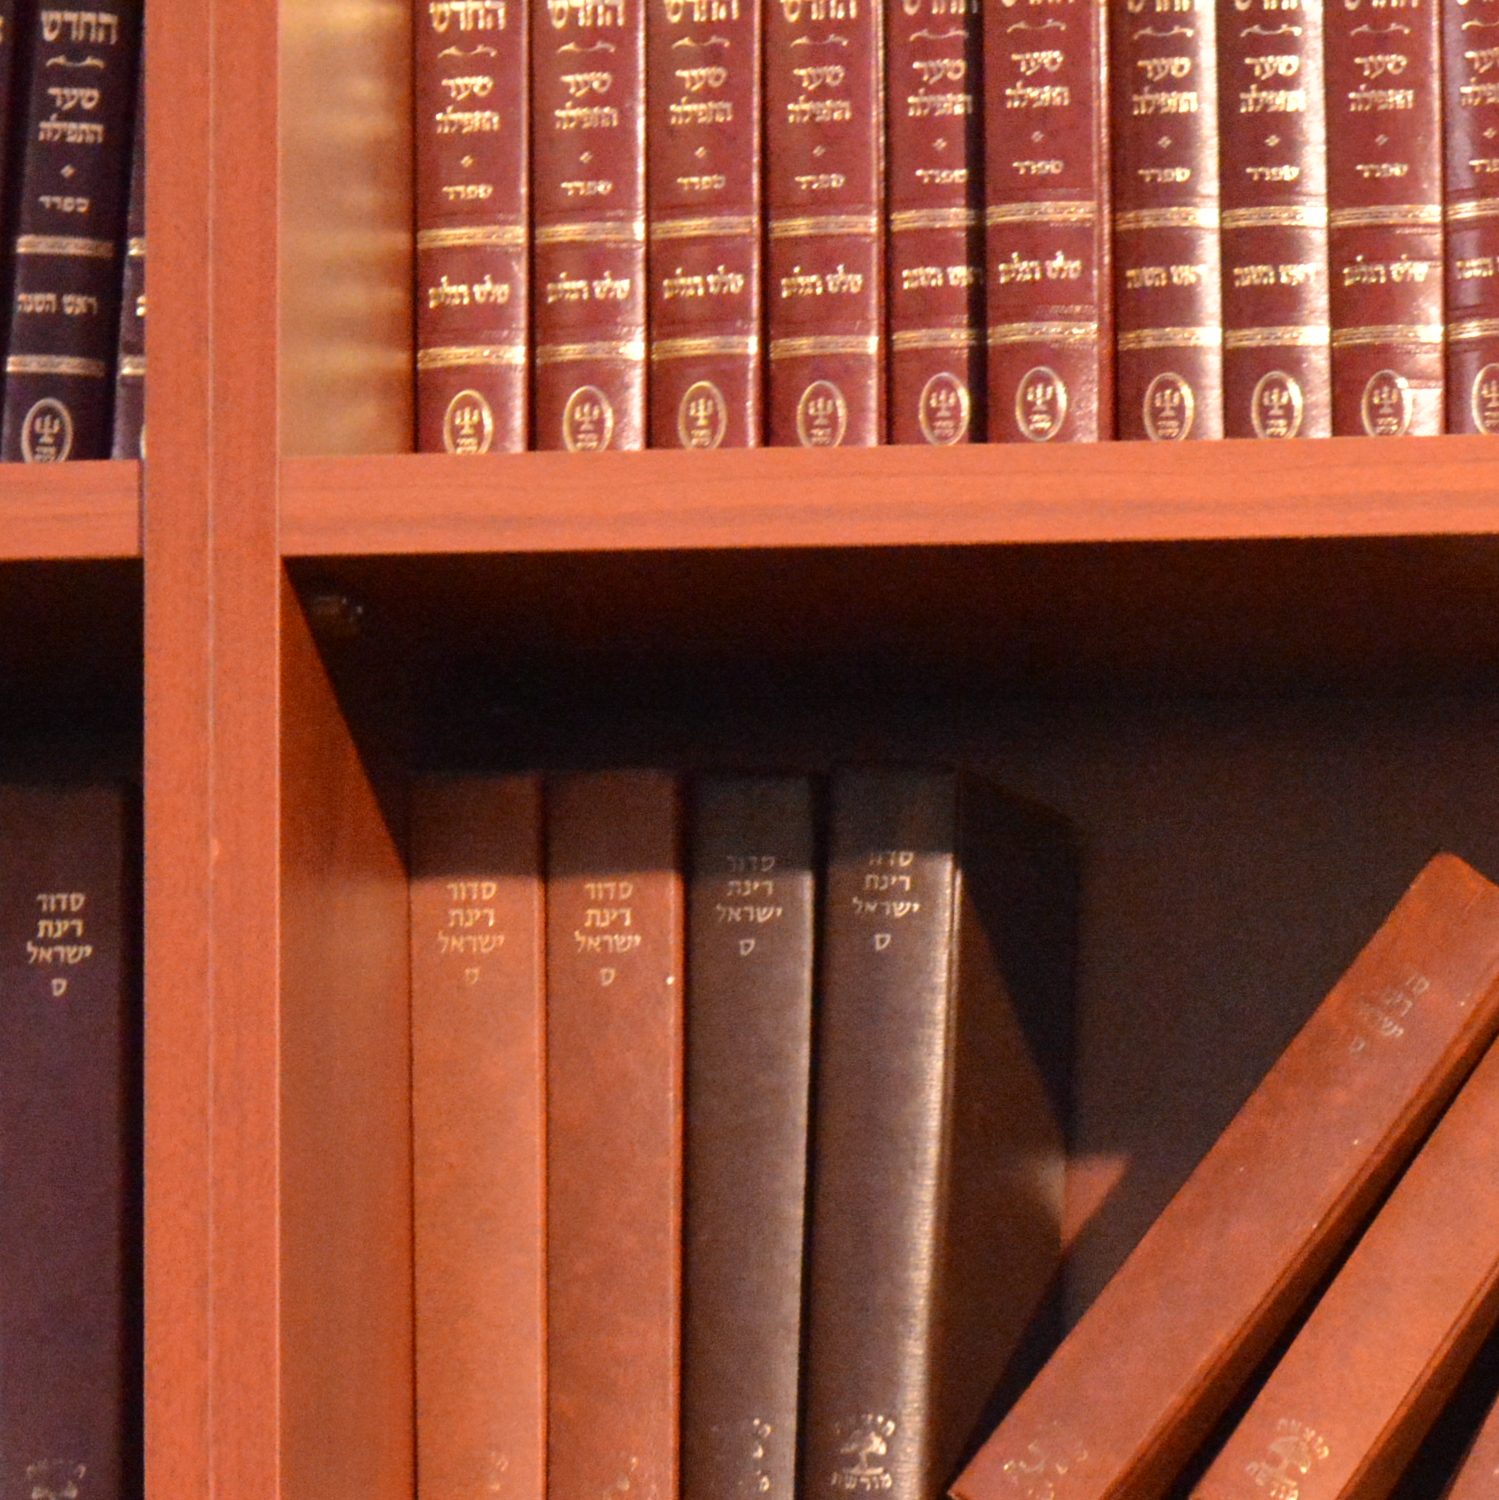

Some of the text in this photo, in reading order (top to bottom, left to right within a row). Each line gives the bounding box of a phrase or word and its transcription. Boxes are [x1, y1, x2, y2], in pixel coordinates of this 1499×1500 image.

[42, 8, 117, 44] החדש
[49, 86, 99, 111] שער
[39, 116, 103, 144] התפילה
[41, 195, 89, 212] ספרד
[17, 292, 97, 314] ראש השנה
[447, 880, 497, 900] סדור
[584, 880, 633, 900] סדור
[727, 878, 774, 898] רינת
[36, 892, 85, 913] סדור
[716, 902, 783, 925] ישראל
[448, 906, 495, 928] רינת
[584, 906, 631, 929] רינת
[37, 919, 83, 939] רינת
[437, 931, 504, 955] ישראל
[575, 930, 641, 955] ישראל
[739, 936, 755, 956] ס
[26, 942, 92, 966] ישראל
[51, 977, 66, 997] ס
[600, 966, 616, 986] ס
